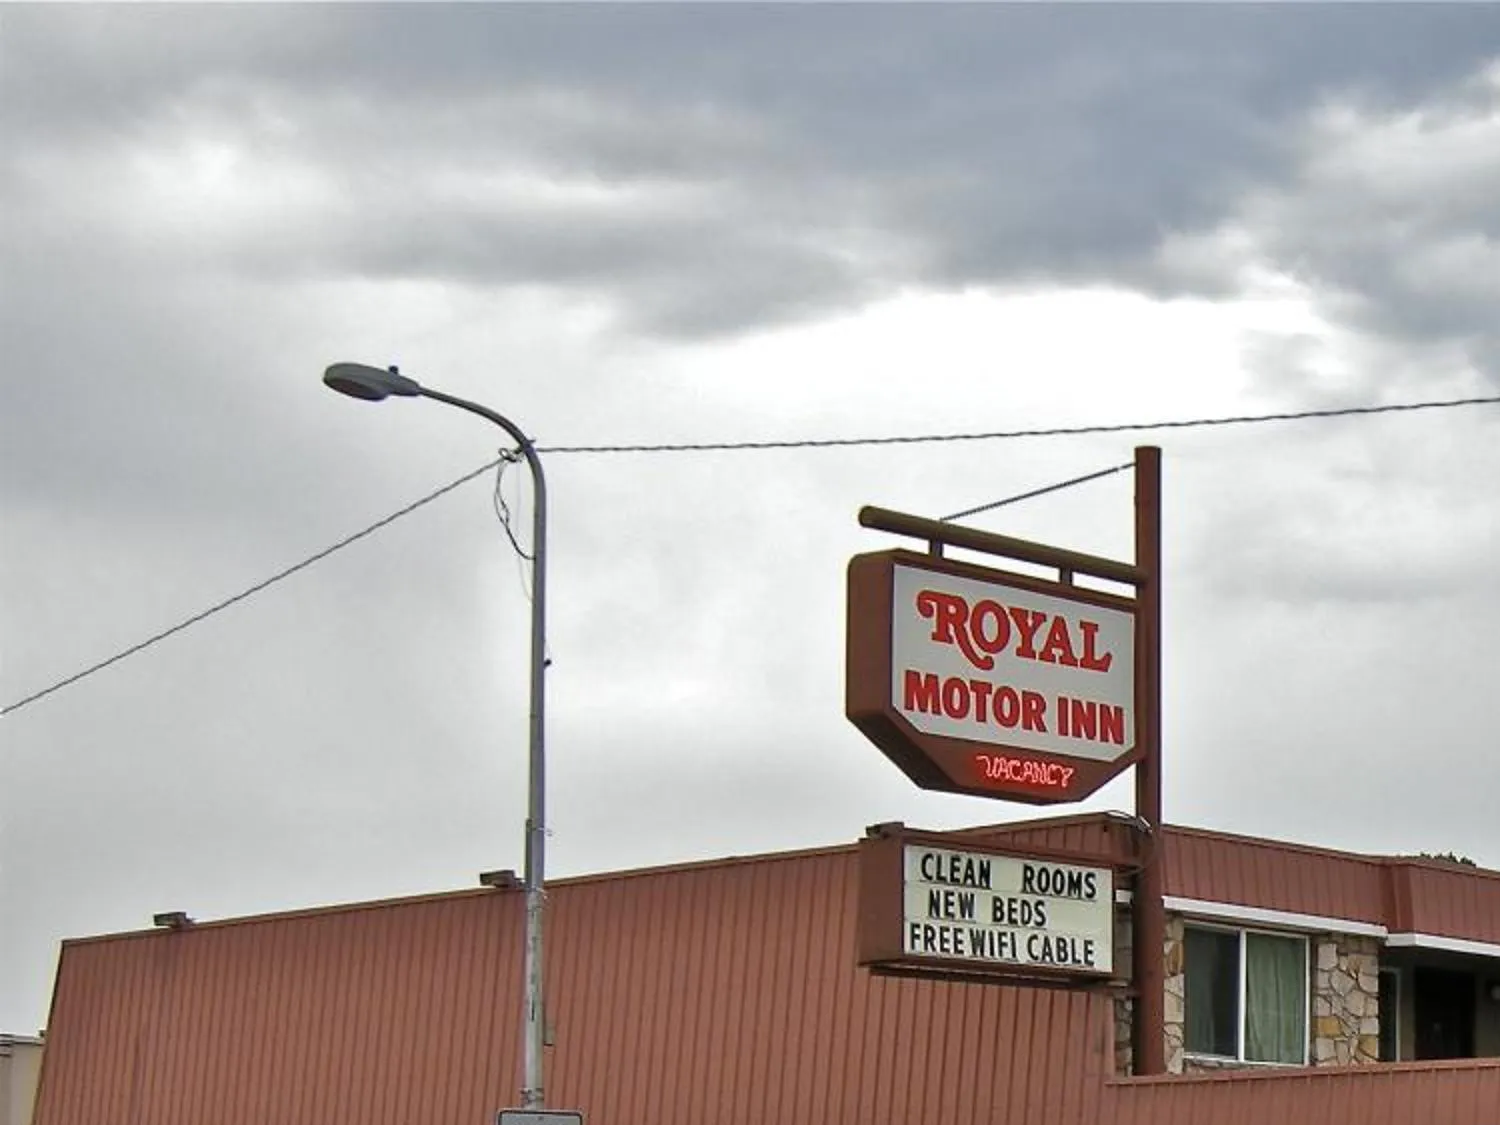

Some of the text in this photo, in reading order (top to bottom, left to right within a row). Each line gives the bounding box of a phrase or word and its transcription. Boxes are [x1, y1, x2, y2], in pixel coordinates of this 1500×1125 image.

[917, 589, 1113, 672] ROYAL
[904, 669, 1125, 744] MOTOR INN
[975, 754, 1075, 788] VACANCY
[920, 853, 1097, 899] CLEAN ROOMS
[928, 889, 1047, 927] NEW BEDS
[909, 922, 1095, 967] FREE WIFI CABLE
